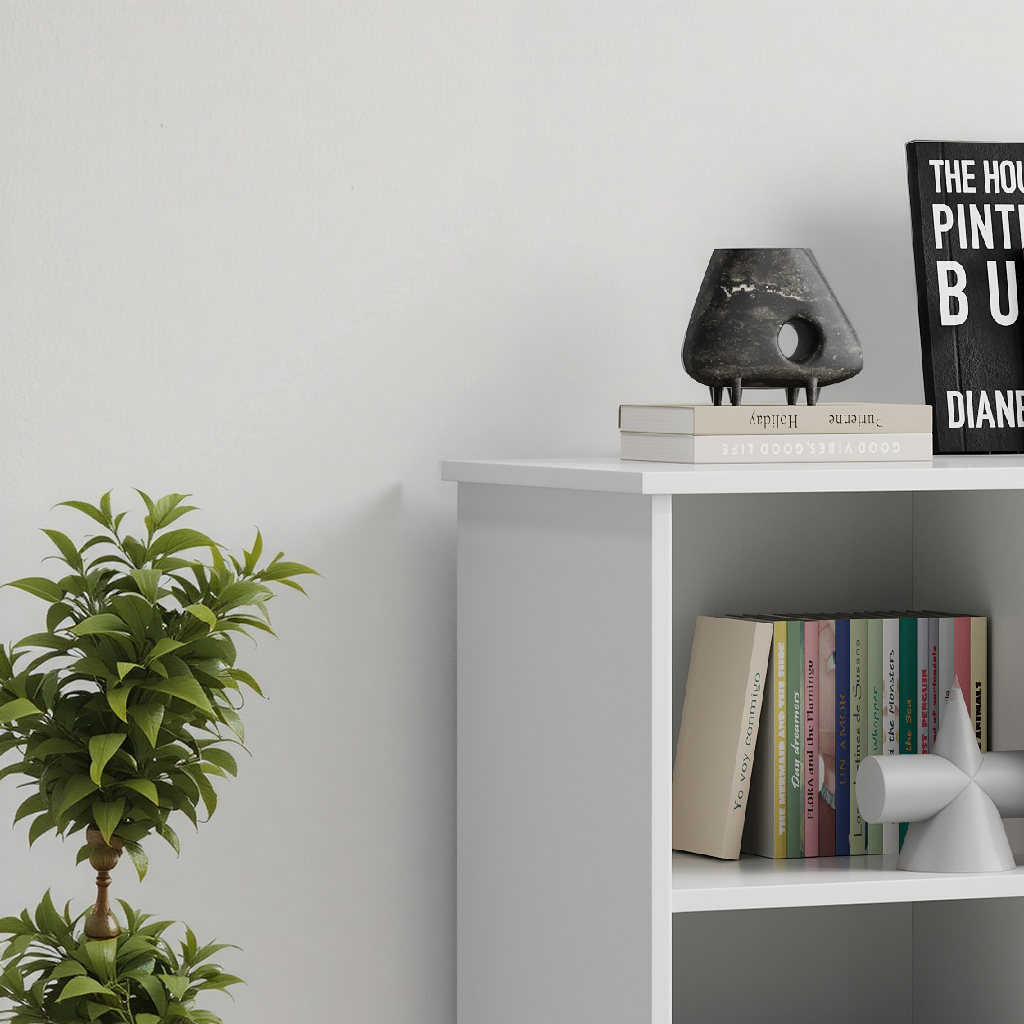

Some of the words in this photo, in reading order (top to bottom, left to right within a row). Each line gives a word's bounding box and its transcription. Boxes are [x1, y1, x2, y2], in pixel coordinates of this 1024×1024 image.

[929, 160, 977, 194] THE
[749, 410, 799, 429] Holiday
[722, 443, 754, 456] LIFE
[760, 442, 804, 455] GOOD
[858, 441, 901, 454] GOOD
[778, 642, 786, 678] SHOE
[854, 639, 862, 700] Susana
[778, 680, 786, 708] THE
[806, 660, 815, 722] Flamingo
[887, 649, 896, 714] Monsters
[744, 672, 762, 746] conmigo
[790, 690, 800, 755] dreamers
[839, 694, 847, 750] AMOR
[853, 704, 861, 723] de
[872, 686, 880, 751] Whopper
[778, 712, 786, 738] AND
[806, 725, 814, 746] the
[887, 719, 896, 743] the
[740, 752, 751, 782] voy
[778, 740, 786, 805] MERMAID
[790, 758, 803, 789] Day
[806, 750, 814, 775] and
[839, 760, 847, 785] UN
[733, 790, 745, 812] Yo
[806, 778, 814, 820] FLORA
[778, 808, 786, 835] THE
